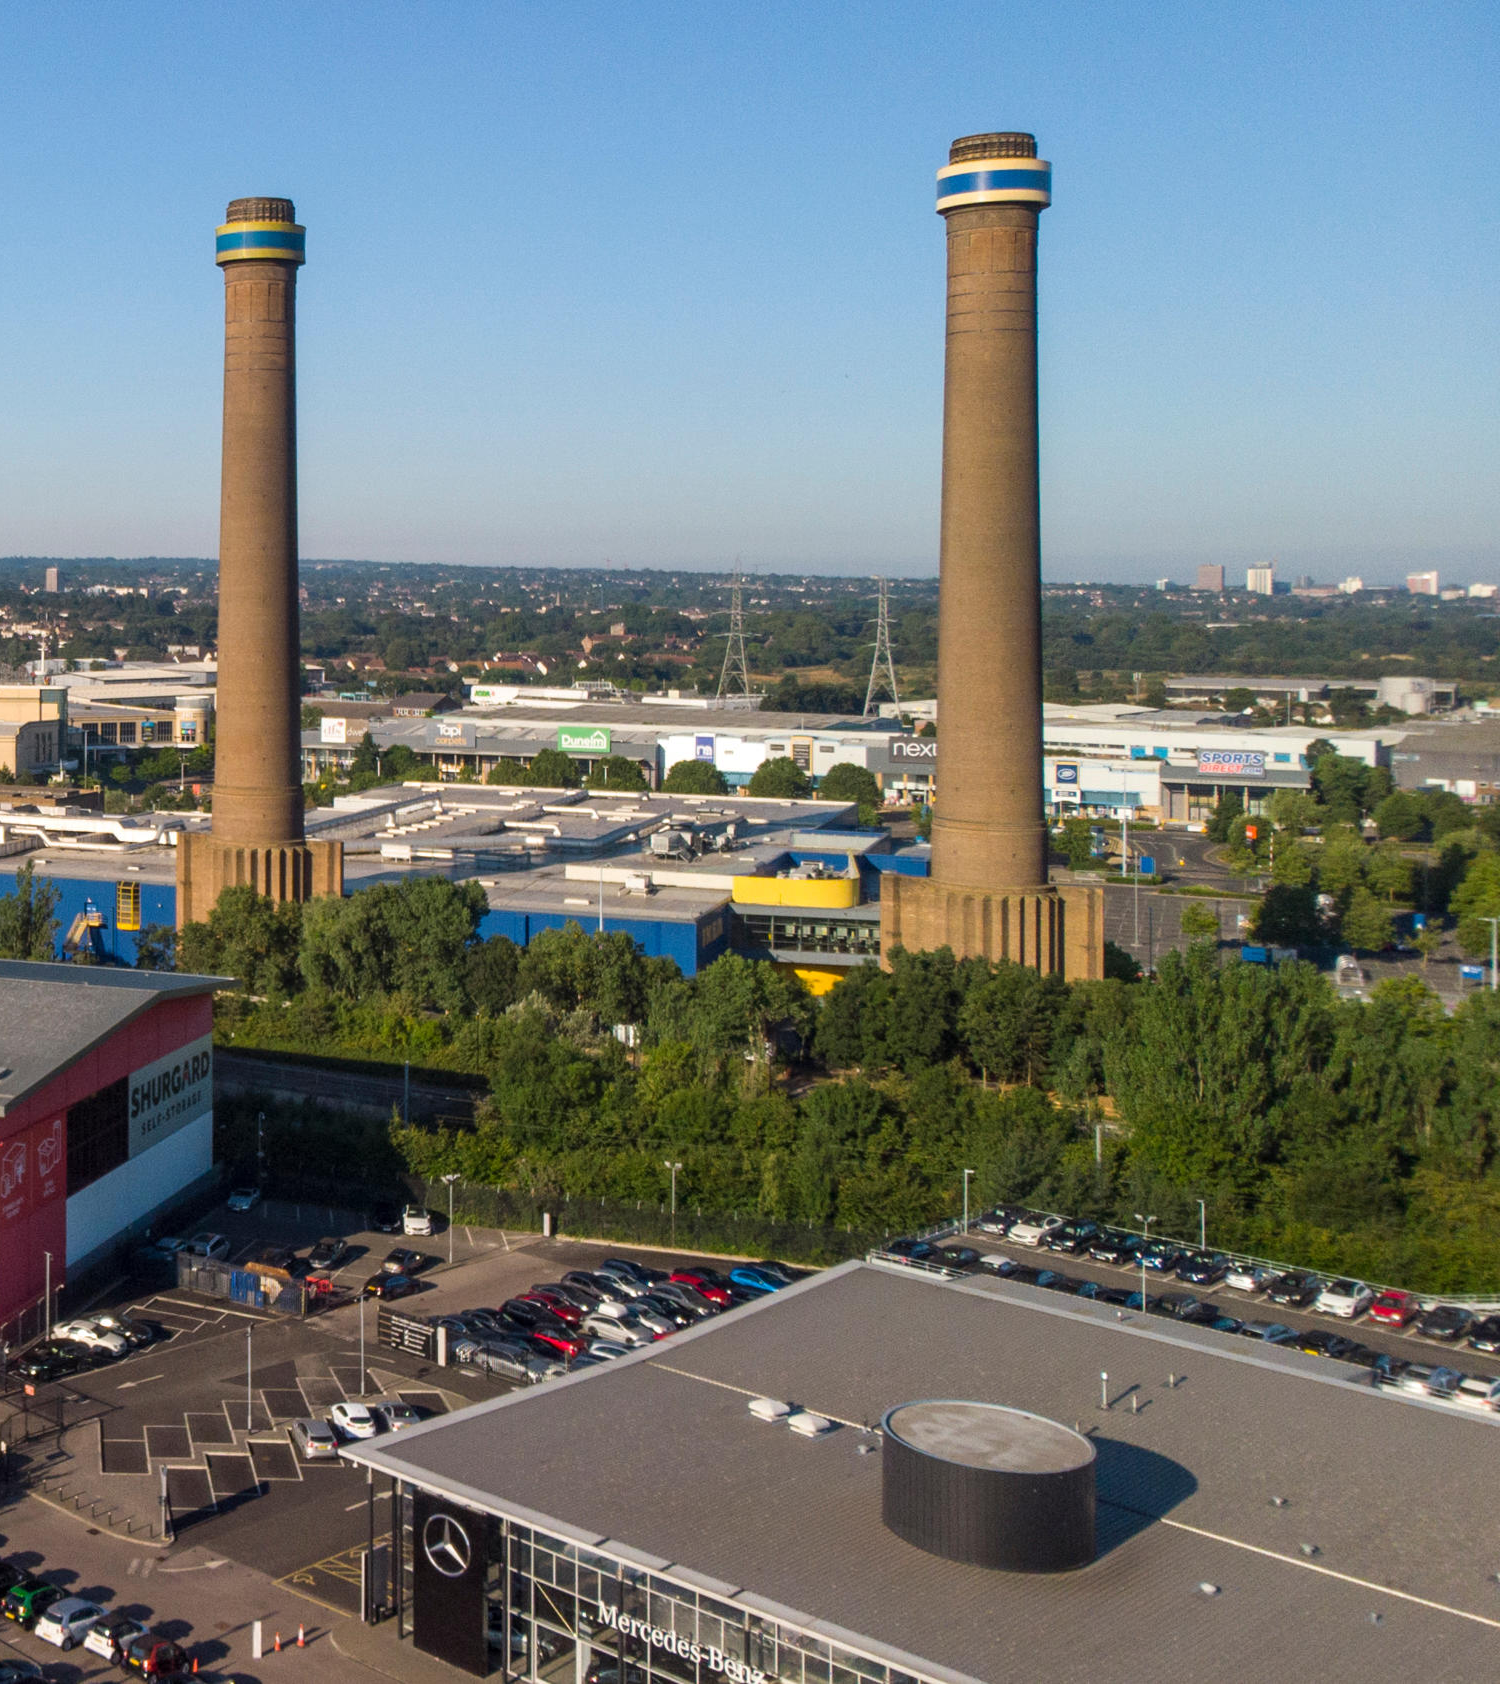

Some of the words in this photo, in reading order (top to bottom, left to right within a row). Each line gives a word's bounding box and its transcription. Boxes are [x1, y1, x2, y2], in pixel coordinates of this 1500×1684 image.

[437, 723, 463, 738] Tapi
[561, 733, 607, 748] Dunelm
[1201, 752, 1264, 766] SPORTS
[131, 1051, 211, 1118] SHURGARD
[141, 1091, 202, 1136] SELF-STORAGE
[598, 1601, 765, 1684] Mercedes-Benz
